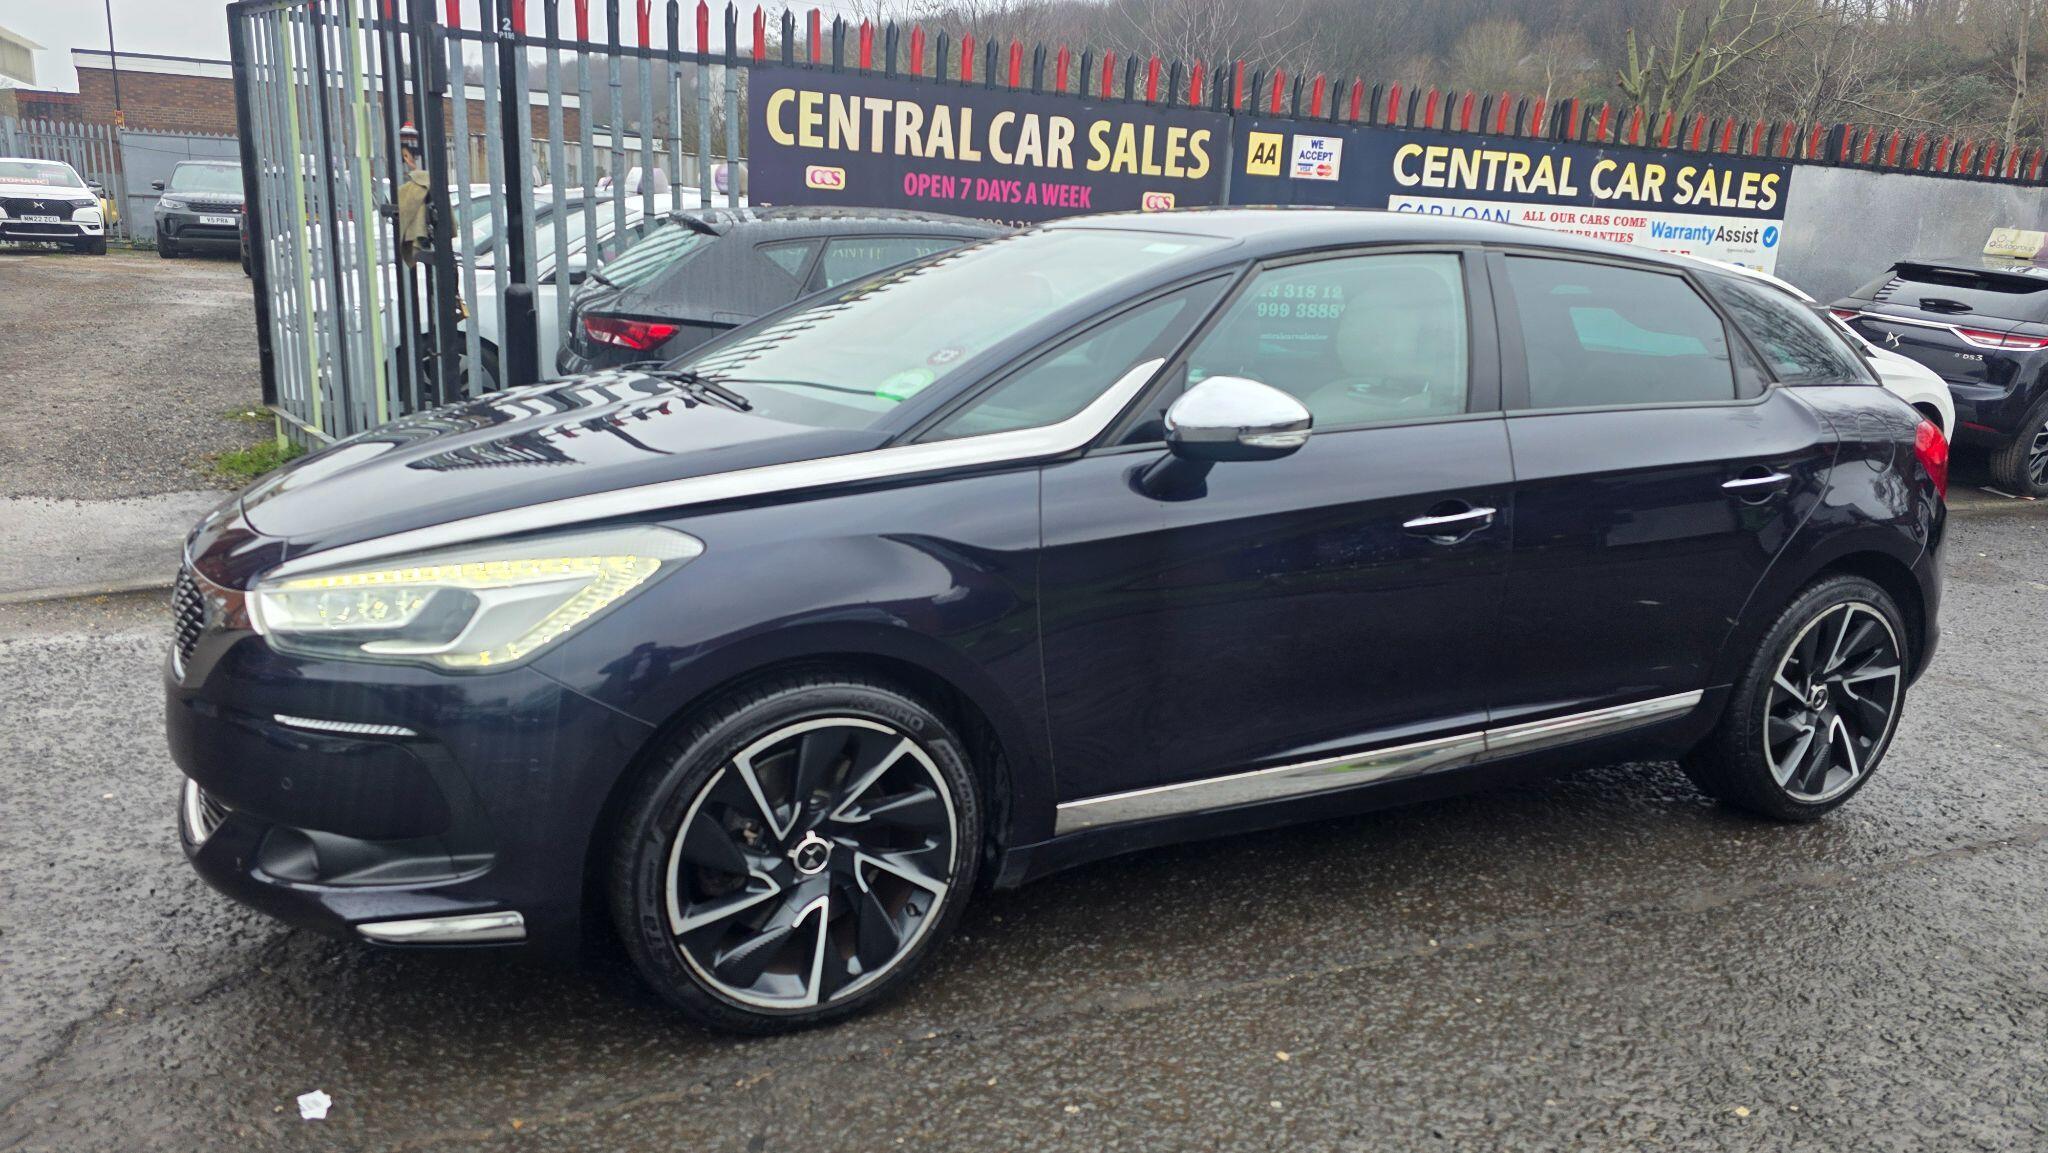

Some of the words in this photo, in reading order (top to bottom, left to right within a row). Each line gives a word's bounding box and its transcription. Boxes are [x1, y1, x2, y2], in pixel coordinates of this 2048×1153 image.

[502, 17, 512, 31] 2
[766, 88, 982, 162] CENTRAL
[988, 110, 1074, 170] CAR
[1086, 120, 1211, 180] SALES
[1311, 139, 1324, 149] WE
[1251, 142, 1278, 165] AA
[1298, 150, 1334, 162] ACCEPT
[1393, 143, 1578, 197] CENTRAL
[1590, 159, 1667, 203] CAR
[1672, 165, 1781, 211] SALES
[904, 172, 955, 199] OPEN
[960, 178, 971, 200] 7
[976, 178, 1021, 204] DAYS
[1025, 182, 1037, 205] A
[1042, 183, 1092, 208] WEEK
[1522, 210, 1546, 222] ALL
[1550, 211, 1576, 223] OUR
[1580, 214, 1610, 225] CARS
[1613, 216, 1647, 228] COME
